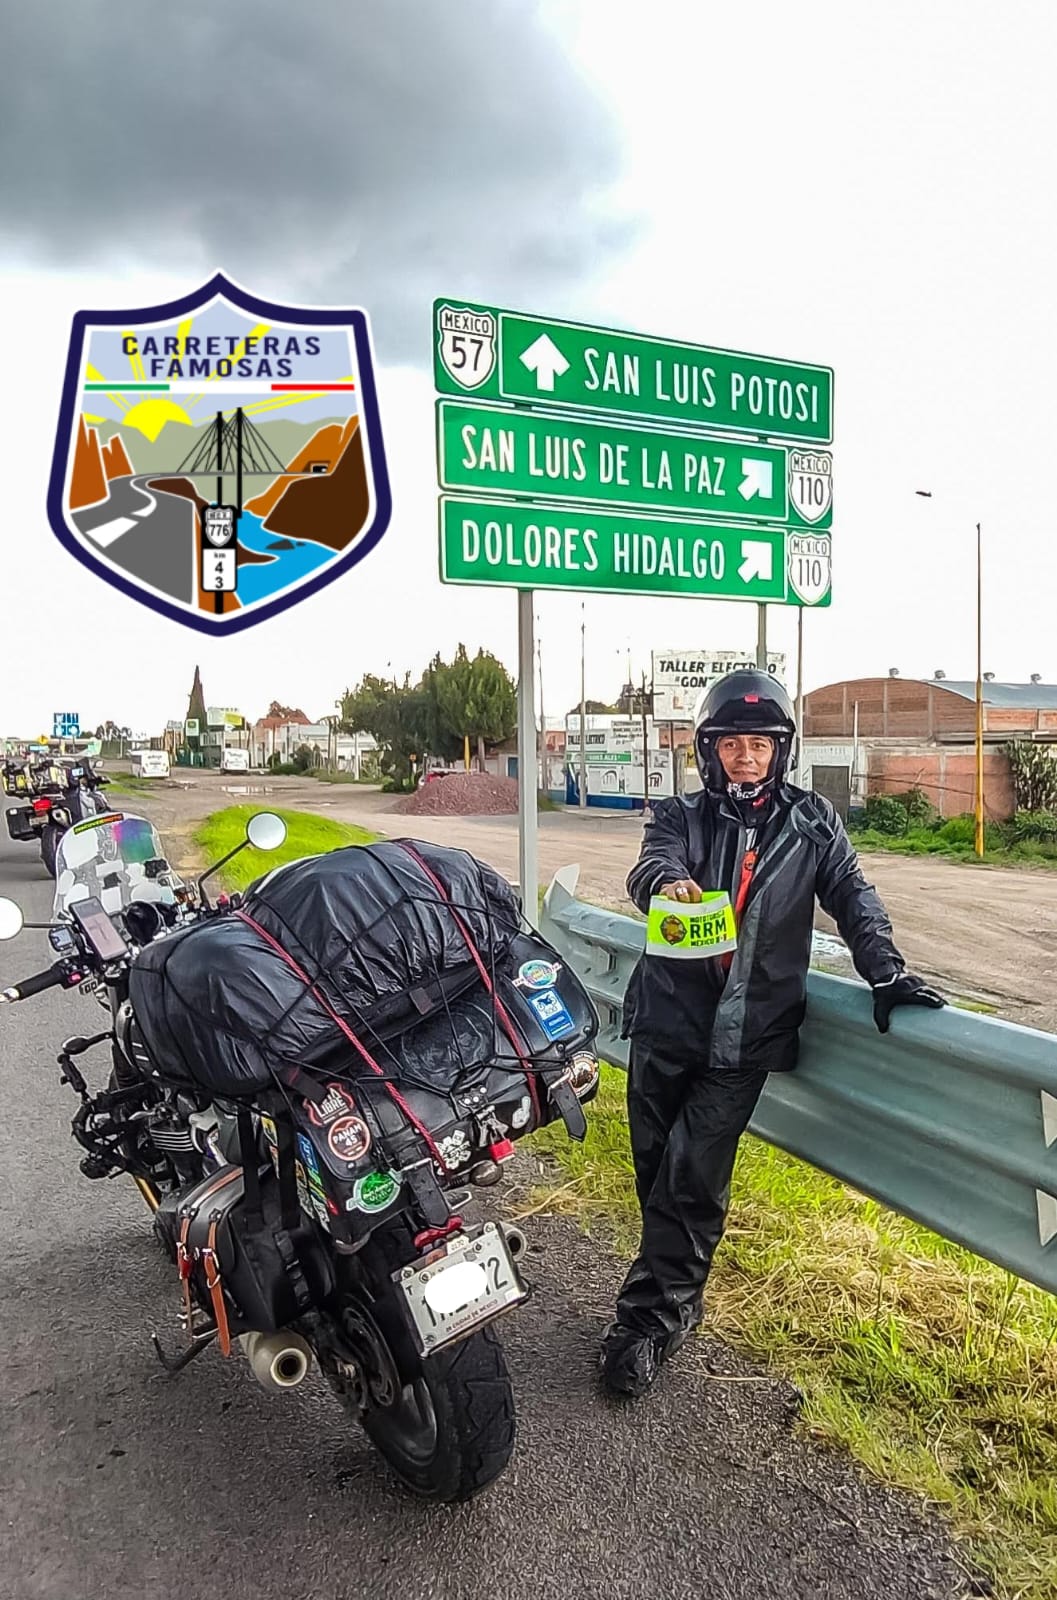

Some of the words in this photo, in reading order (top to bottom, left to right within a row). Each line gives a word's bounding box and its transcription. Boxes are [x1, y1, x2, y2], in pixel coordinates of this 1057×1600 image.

[444, 313, 490, 334] MEXICO
[451, 336, 485, 372] 57
[584, 347, 639, 397] SAN
[655, 361, 717, 408] LUIS
[731, 371, 819, 423] POTOSI
[461, 424, 515, 474] SAN
[528, 432, 586, 482] LUIS
[599, 441, 629, 485] DE
[642, 447, 673, 491] LA
[684, 452, 726, 497] PAZ
[792, 453, 829, 474] MEXICO
[798, 475, 825, 507] 110
[461, 519, 599, 572] DOLORES
[613, 532, 725, 582] HIDALGO
[792, 537, 828, 556] MEXICO
[797, 557, 823, 587] 110
[659, 660, 705, 673] TALLER
[690, 917, 727, 939] RRM
